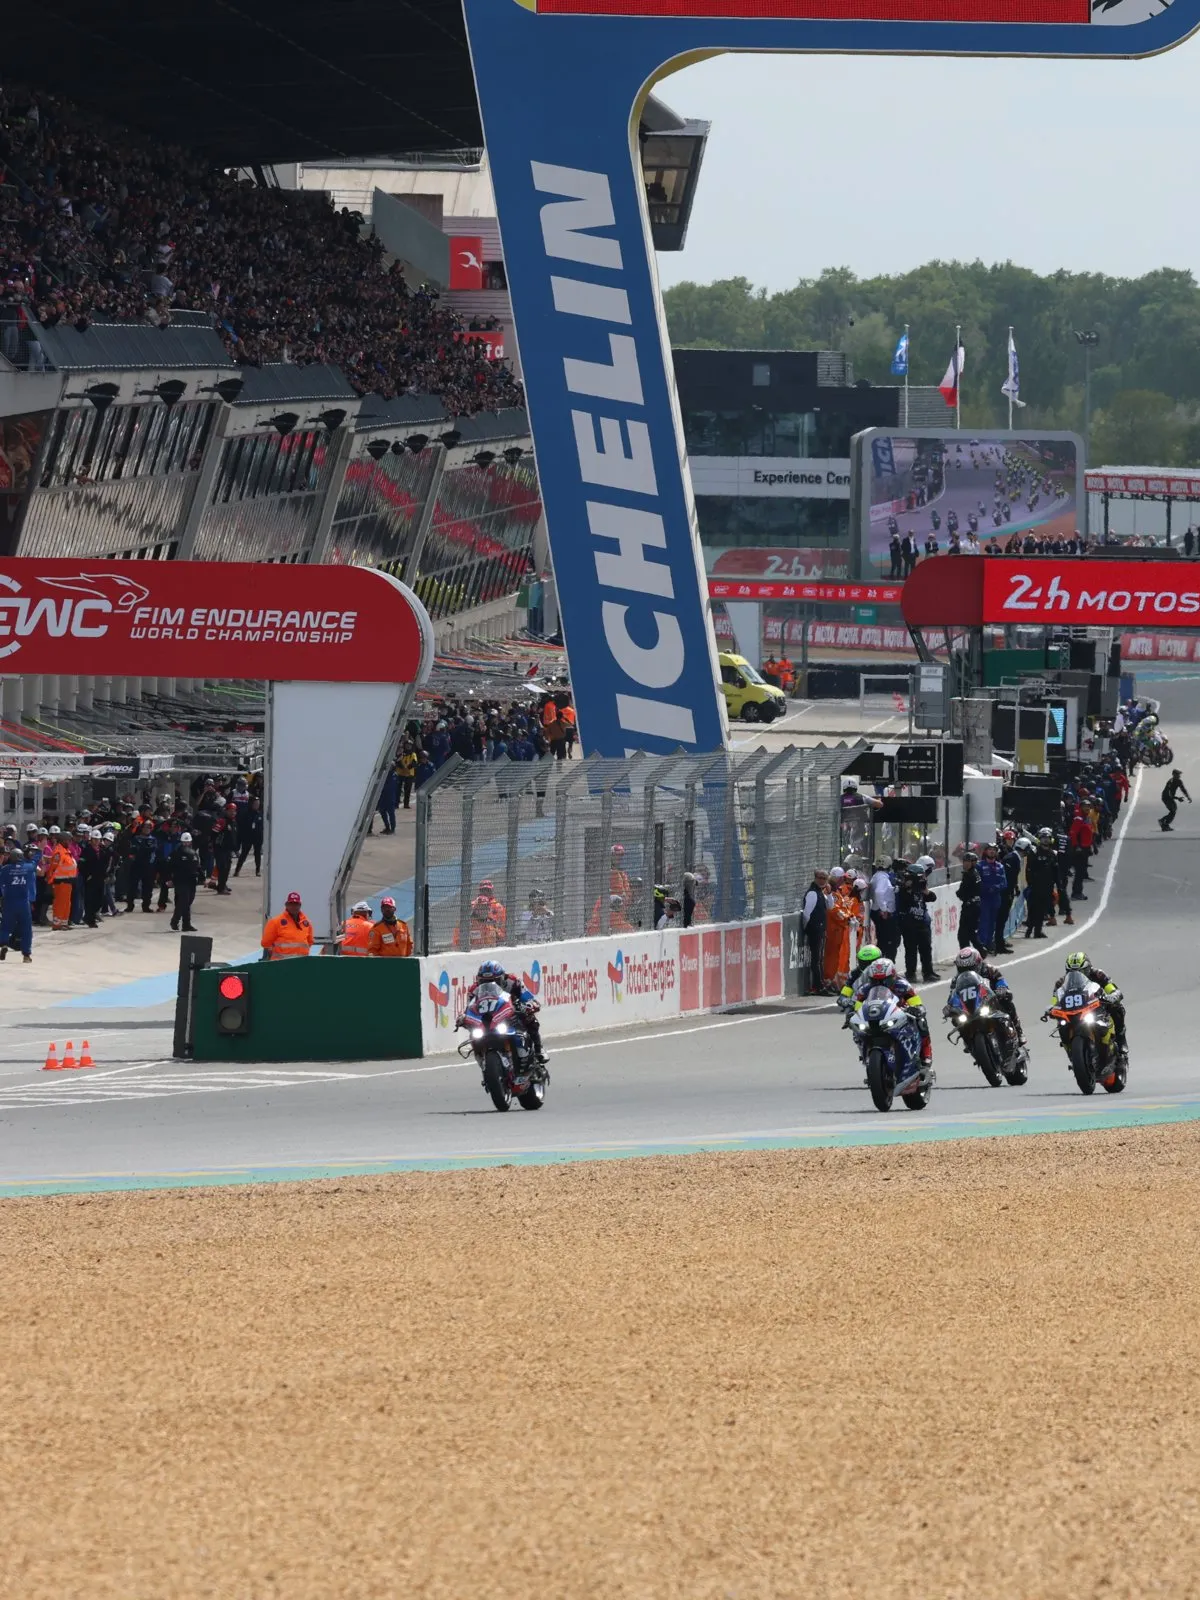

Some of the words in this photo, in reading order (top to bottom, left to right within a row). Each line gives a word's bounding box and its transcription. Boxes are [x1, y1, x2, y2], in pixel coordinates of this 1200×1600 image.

[754, 470, 822, 486] Experience
[1003, 574, 1070, 610] 24h
[1077, 591, 1200, 612] MOTOS
[133, 606, 184, 625] FIM
[191, 608, 358, 629] ENDURANCE
[130, 627, 199, 640] WORLD
[204, 628, 353, 644] CHAMPIONSHIP
[624, 949, 676, 1001] TotalEnergies
[542, 958, 598, 1014] TotalEnergies
[960, 986, 977, 1001] 76
[478, 999, 499, 1014] 37
[1064, 994, 1083, 1008] 99
